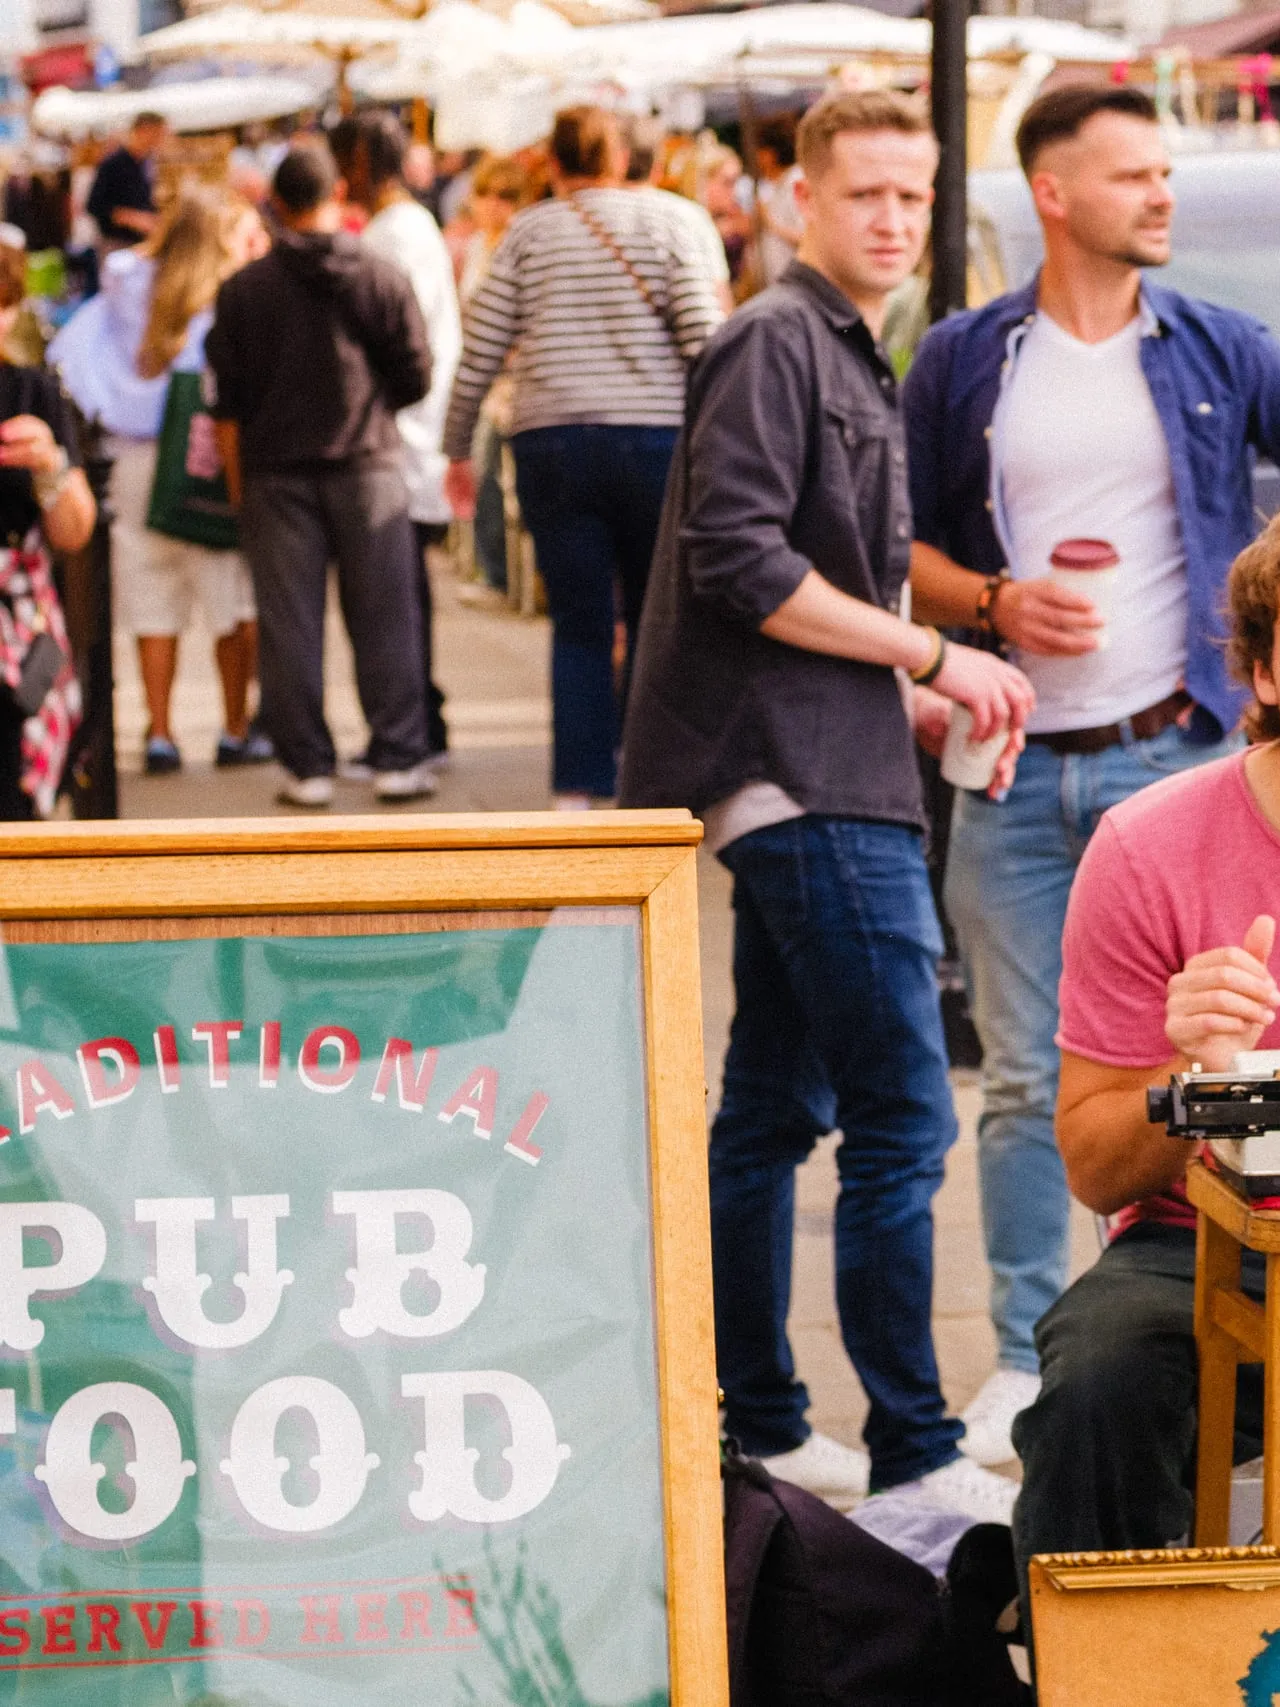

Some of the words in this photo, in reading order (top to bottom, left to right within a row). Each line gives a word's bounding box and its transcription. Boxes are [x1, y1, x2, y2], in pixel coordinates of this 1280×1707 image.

[0, 1189, 487, 1350] PUB
[0, 1370, 572, 1540] OOD
[0, 1599, 272, 1657] SERVED
[299, 1588, 480, 1645] HERE
